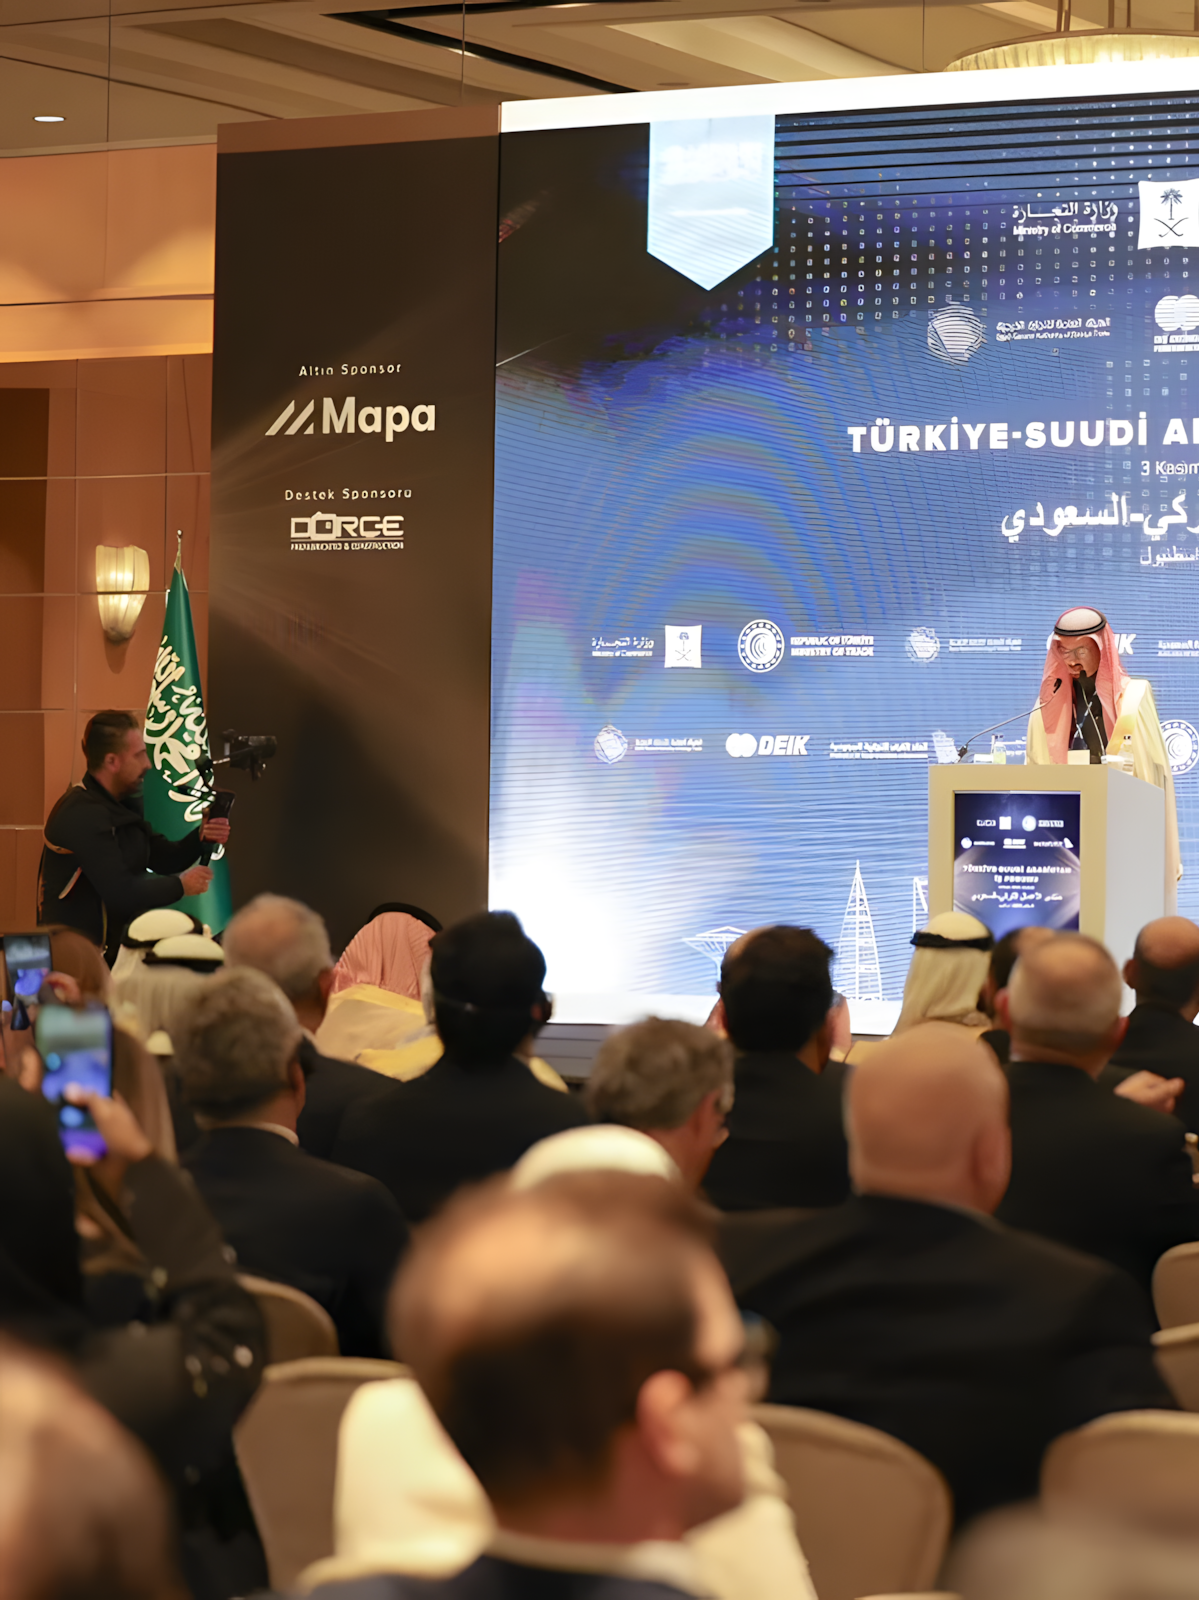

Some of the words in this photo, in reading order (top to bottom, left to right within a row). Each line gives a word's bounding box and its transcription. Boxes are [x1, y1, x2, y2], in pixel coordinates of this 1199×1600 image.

[341, 364, 402, 377] Sponsor
[322, 396, 436, 443] Mapa
[847, 411, 1148, 453] TÜRKİYE-SUUDİ
[1141, 461, 1150, 476] 3
